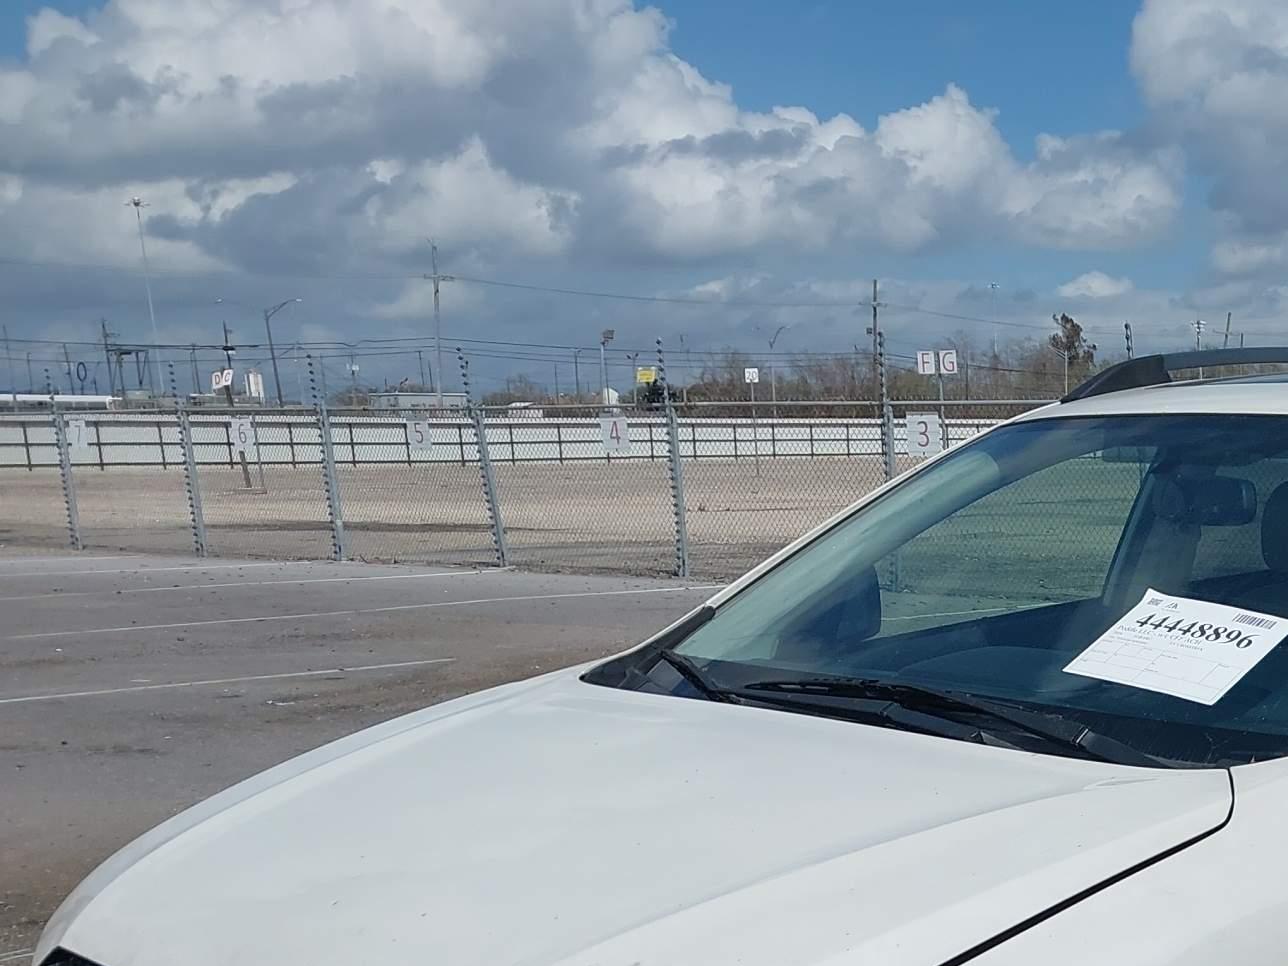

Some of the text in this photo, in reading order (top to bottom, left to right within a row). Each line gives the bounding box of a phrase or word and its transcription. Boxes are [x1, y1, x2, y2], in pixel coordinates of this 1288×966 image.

[921, 353, 930, 373] F
[942, 352, 955, 372] G
[238, 423, 247, 443] 6
[413, 422, 424, 443] 5
[609, 420, 620, 444] 4
[916, 420, 930, 448] 3
[1136, 613, 1261, 649] 44448896
